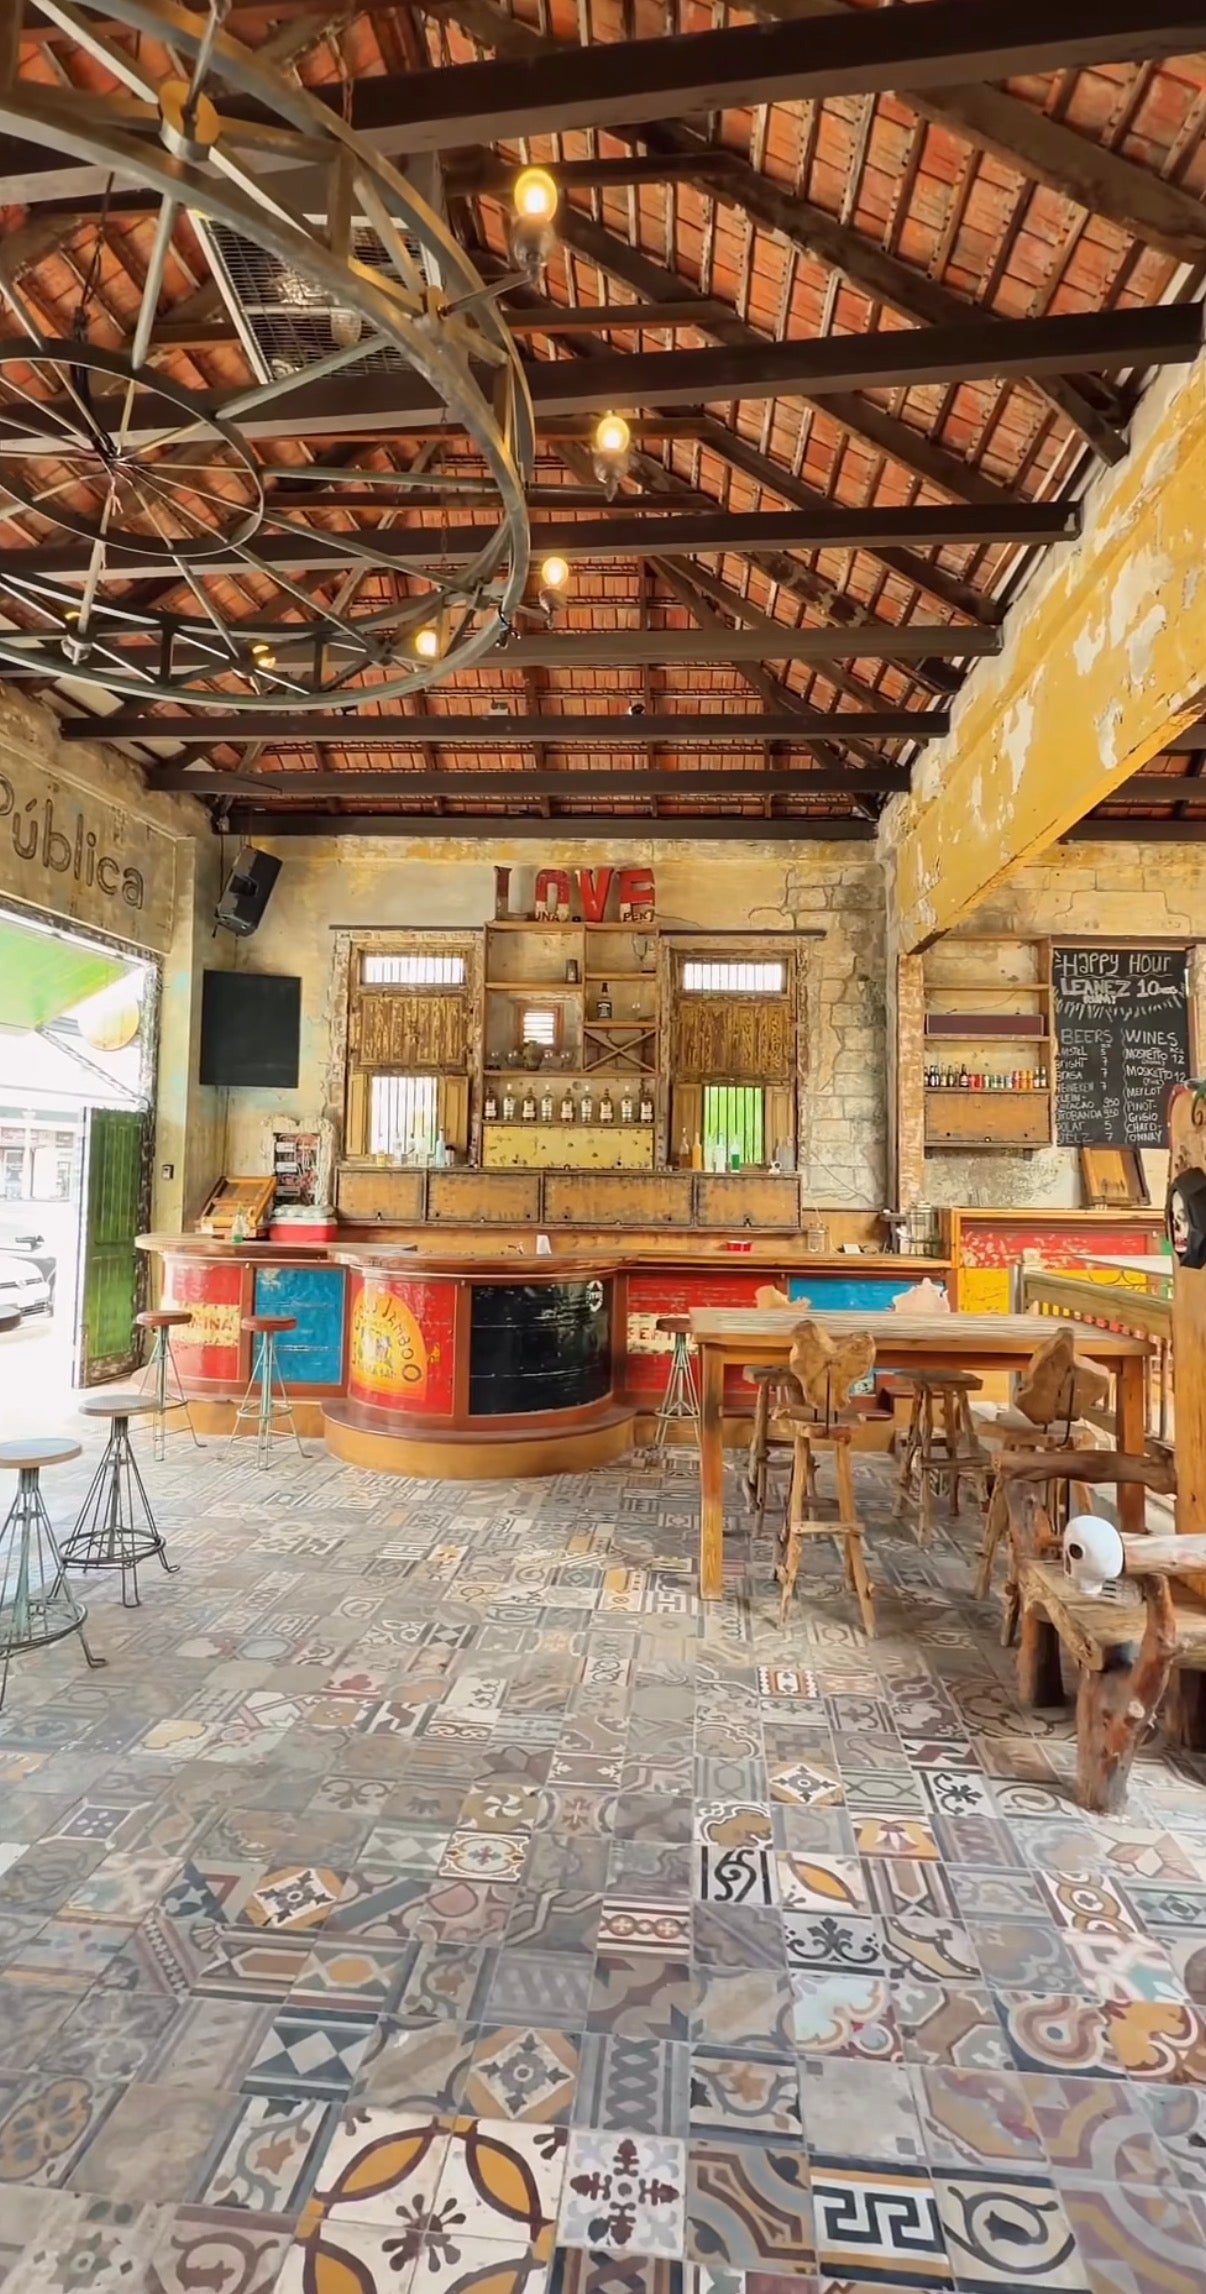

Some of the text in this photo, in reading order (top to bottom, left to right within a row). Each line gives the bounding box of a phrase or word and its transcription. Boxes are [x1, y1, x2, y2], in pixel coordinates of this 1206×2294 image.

[494, 865, 655, 922] LOVE
[1128, 953, 1172, 974] Hour
[1061, 1028, 1179, 1047] BEERS WINES
[1104, 1120, 1113, 1130] 5
[1104, 1132, 1114, 1142] 7
